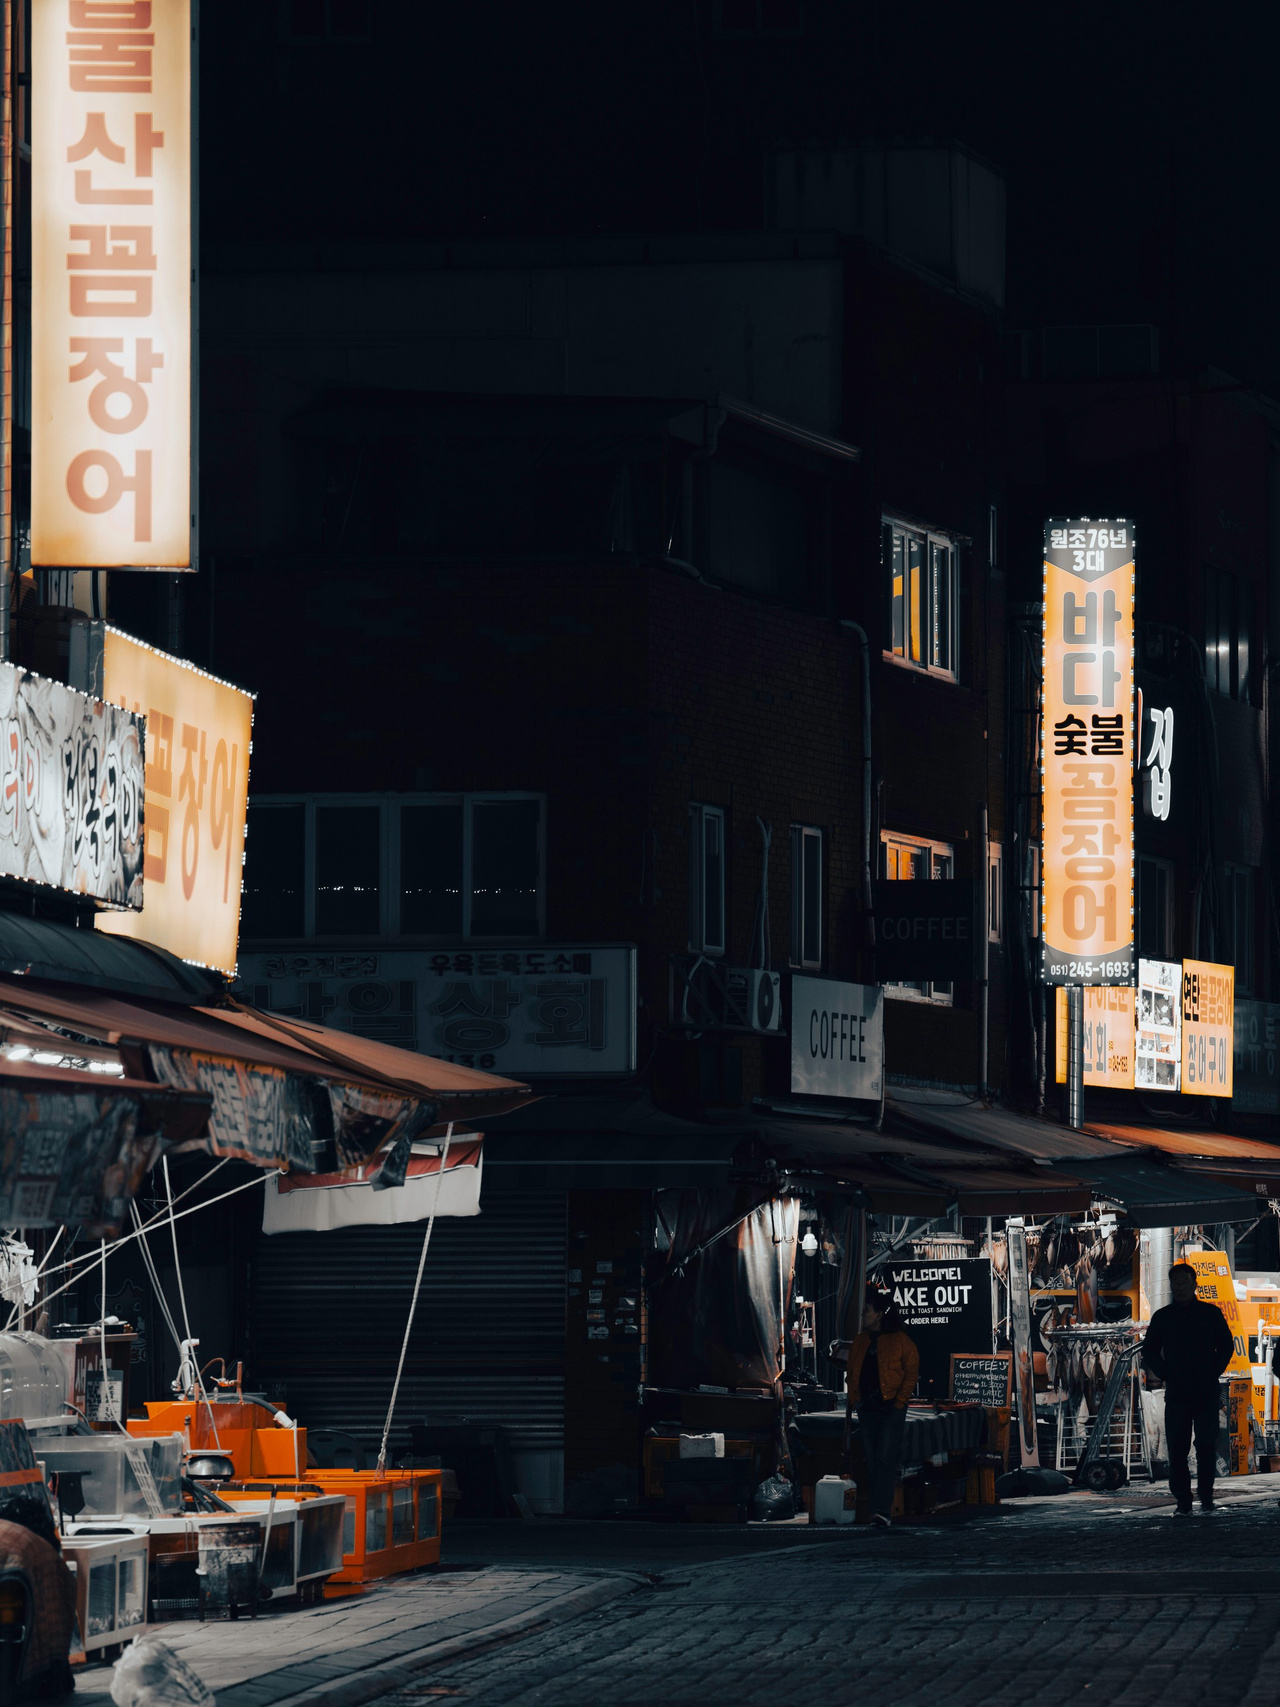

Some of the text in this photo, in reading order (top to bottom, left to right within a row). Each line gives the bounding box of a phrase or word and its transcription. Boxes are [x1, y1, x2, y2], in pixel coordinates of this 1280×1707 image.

[1050, 528, 1127, 549] 원조76년
[1072, 551, 1105, 572] 3대
[1062, 589, 1122, 708] 바다
[1053, 714, 1125, 756] 숯불
[1137, 687, 1174, 822] 집
[1060, 763, 1122, 942] 꼼장어
[881, 917, 969, 940] COFFEE
[810, 1009, 867, 1063] COFFEE
[1188, 1034, 1227, 1085] 장어구이
[934, 1285, 973, 1306] OUT
[910, 1316, 949, 1325] ORDER HERE!
[959, 1360, 998, 1371] COFFEE
